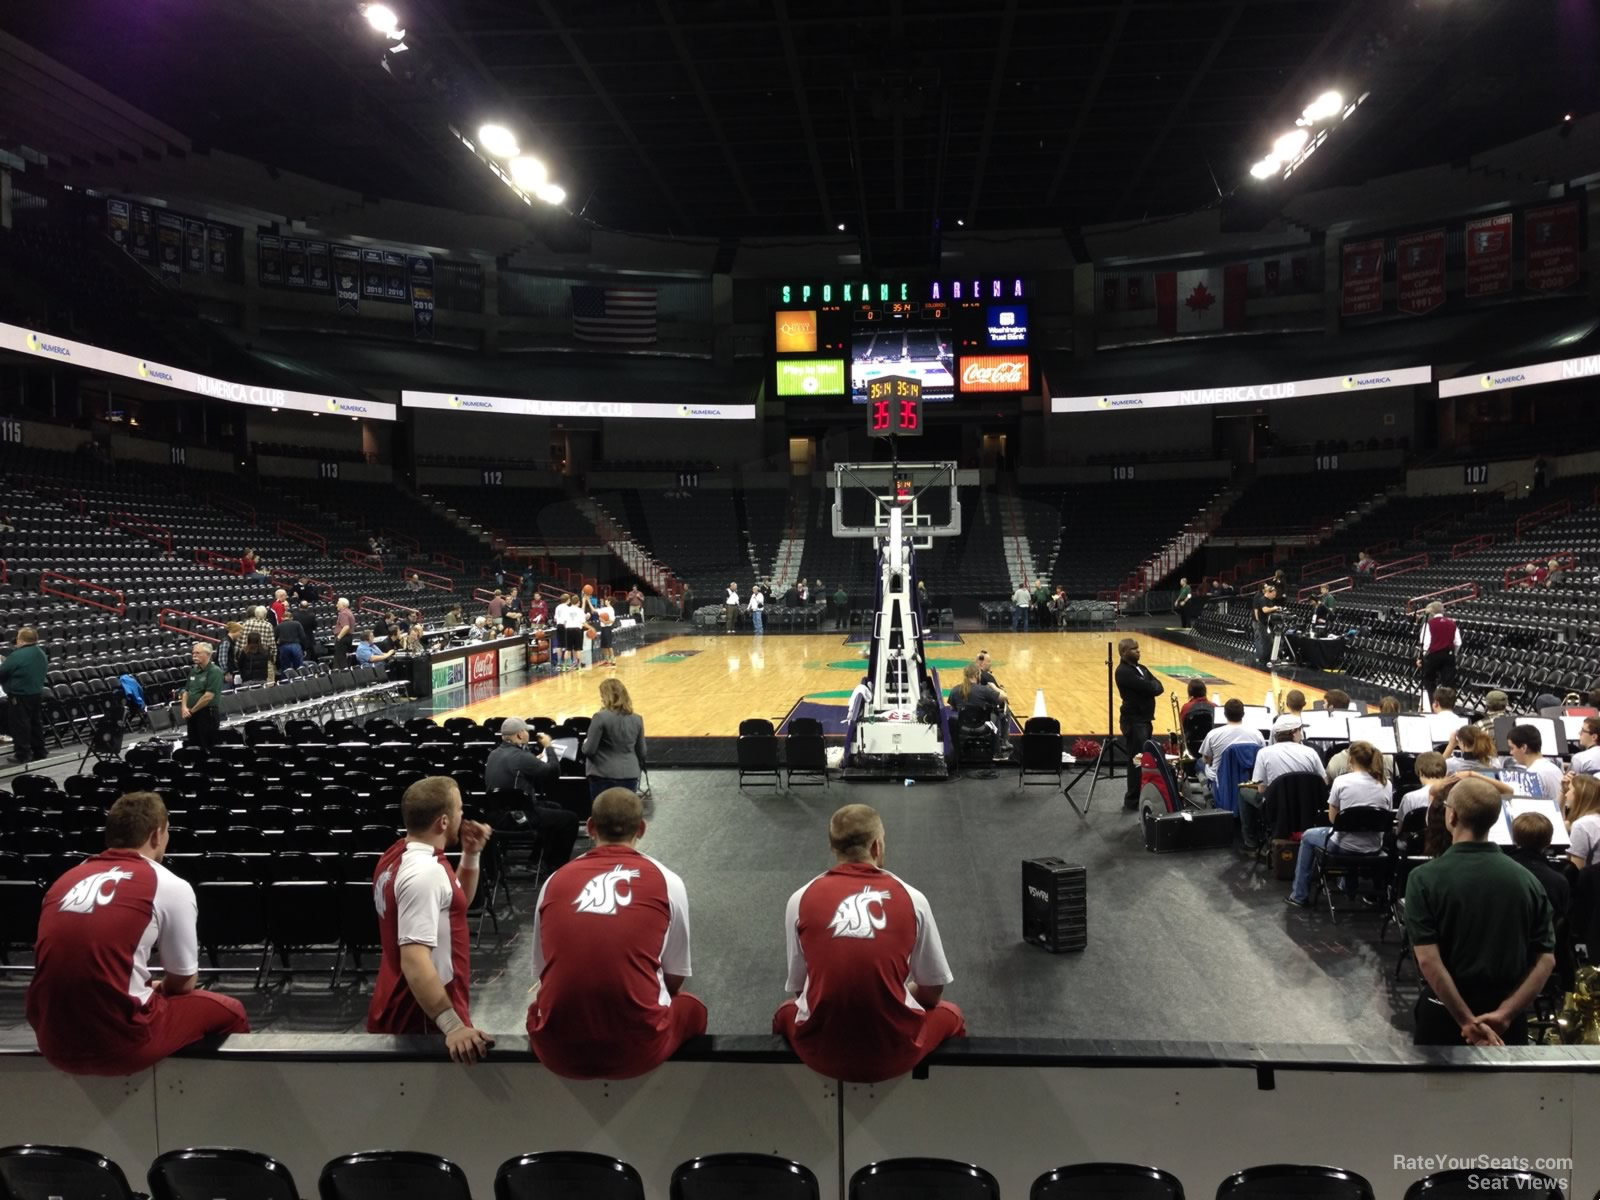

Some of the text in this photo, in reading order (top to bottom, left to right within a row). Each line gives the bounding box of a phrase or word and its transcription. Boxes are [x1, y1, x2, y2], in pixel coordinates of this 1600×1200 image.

[338, 290, 358, 300] 2009
[366, 286, 383, 294] 2010
[387, 288, 404, 297] 2010
[783, 280, 1022, 303] SPOKANE ARENA
[414, 301, 433, 310] 2010
[988, 326, 1027, 335] Washington
[40, 343, 71, 357] NUMERICA
[148, 369, 173, 382] NUMERICA
[1356, 377, 1391, 386] NUMERICA
[1493, 374, 1526, 385] NUMERICA
[197, 375, 286, 406] NUMERICA CLUB
[871, 381, 892, 399] 35:14
[896, 380, 919, 398] 35:14
[1179, 382, 1296, 405] NUMERICA CLUB
[339, 404, 367, 413] NUMERICA
[462, 400, 493, 408] NUMERICA
[599, 402, 633, 417] CLUB
[1111, 399, 1143, 407] NUMERICA
[873, 400, 889, 430] 35
[899, 400, 917, 429] 35
[1, 420, 22, 444] 115
[171, 447, 186, 465] 114
[320, 463, 339, 478] 113
[1113, 467, 1135, 480] 109
[1466, 466, 1487, 482] 107
[483, 471, 503, 485] 112
[679, 474, 698, 487] 111
